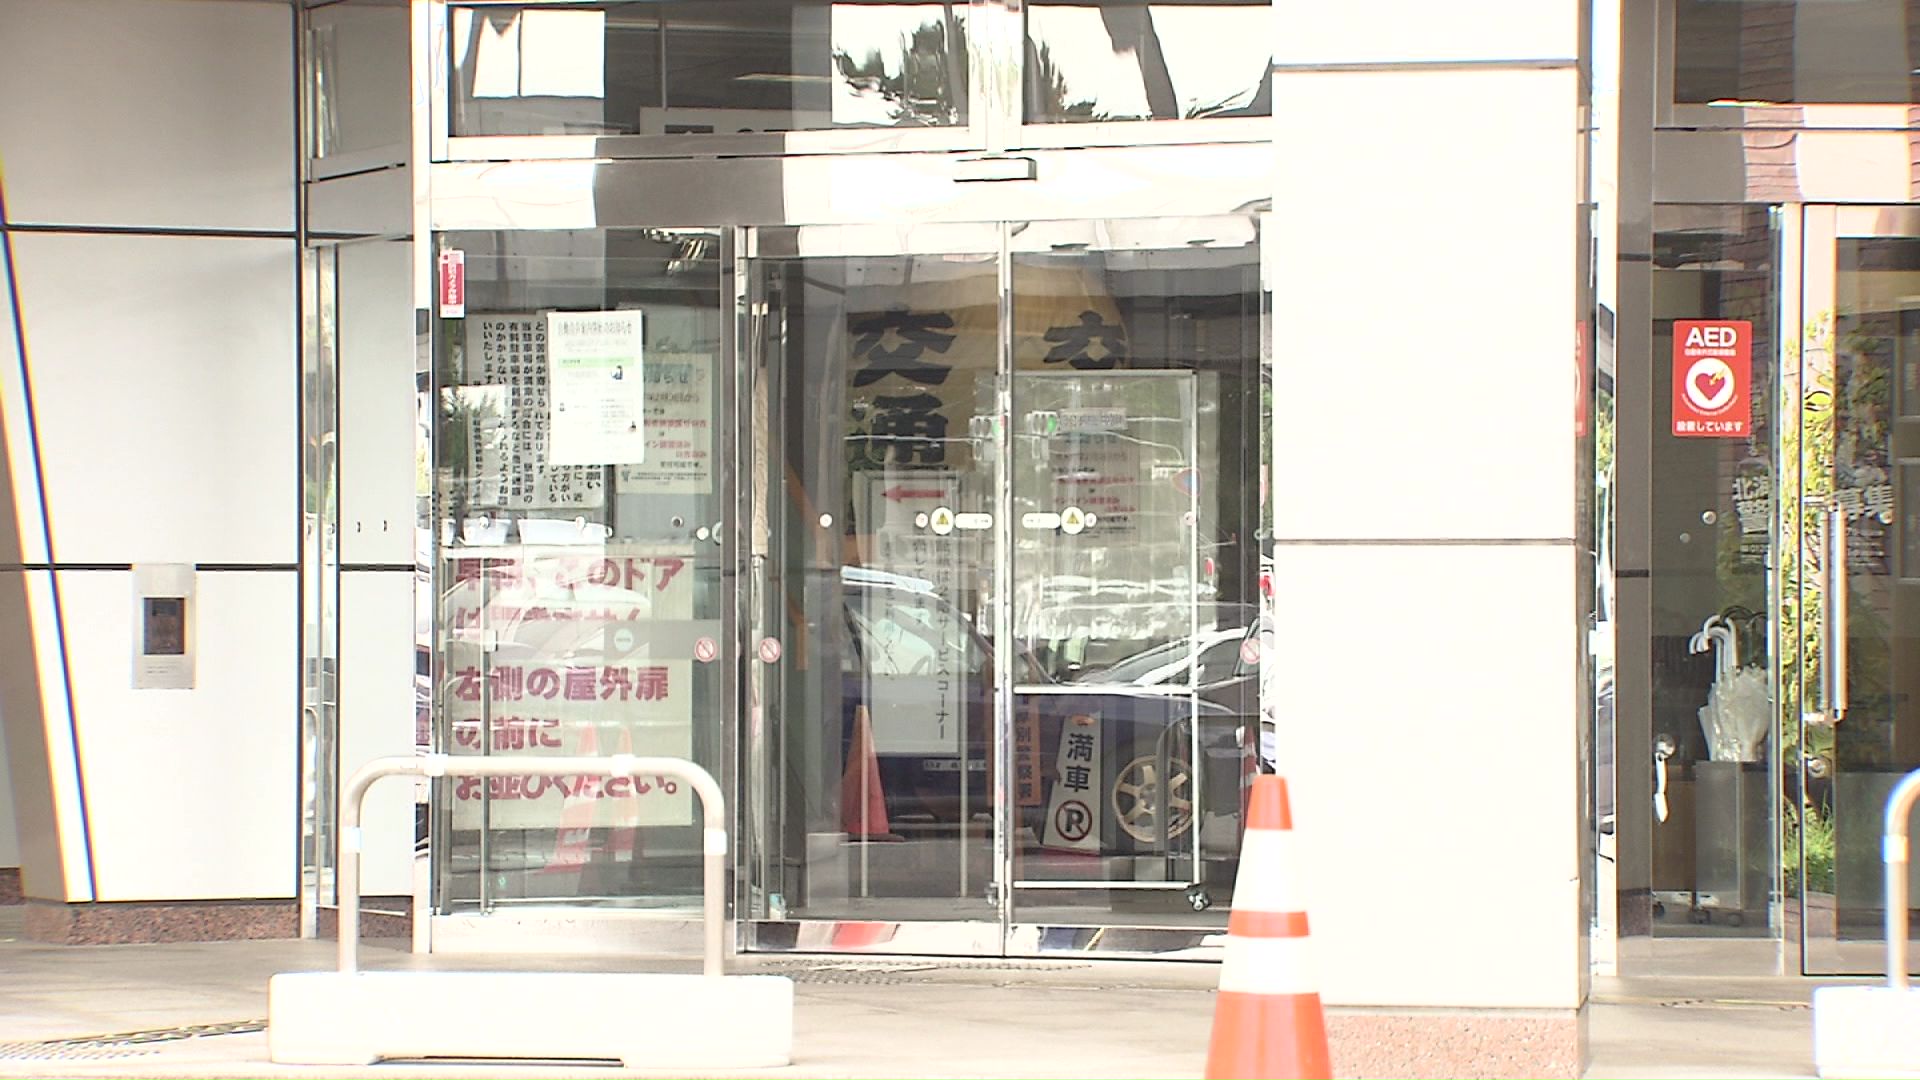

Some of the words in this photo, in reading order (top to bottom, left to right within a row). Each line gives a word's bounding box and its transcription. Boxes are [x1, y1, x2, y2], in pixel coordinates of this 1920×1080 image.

[1685, 327, 1737, 347] AED
[455, 666, 669, 701] 右側の屋外扉
[1063, 733, 1095, 793] 満車
